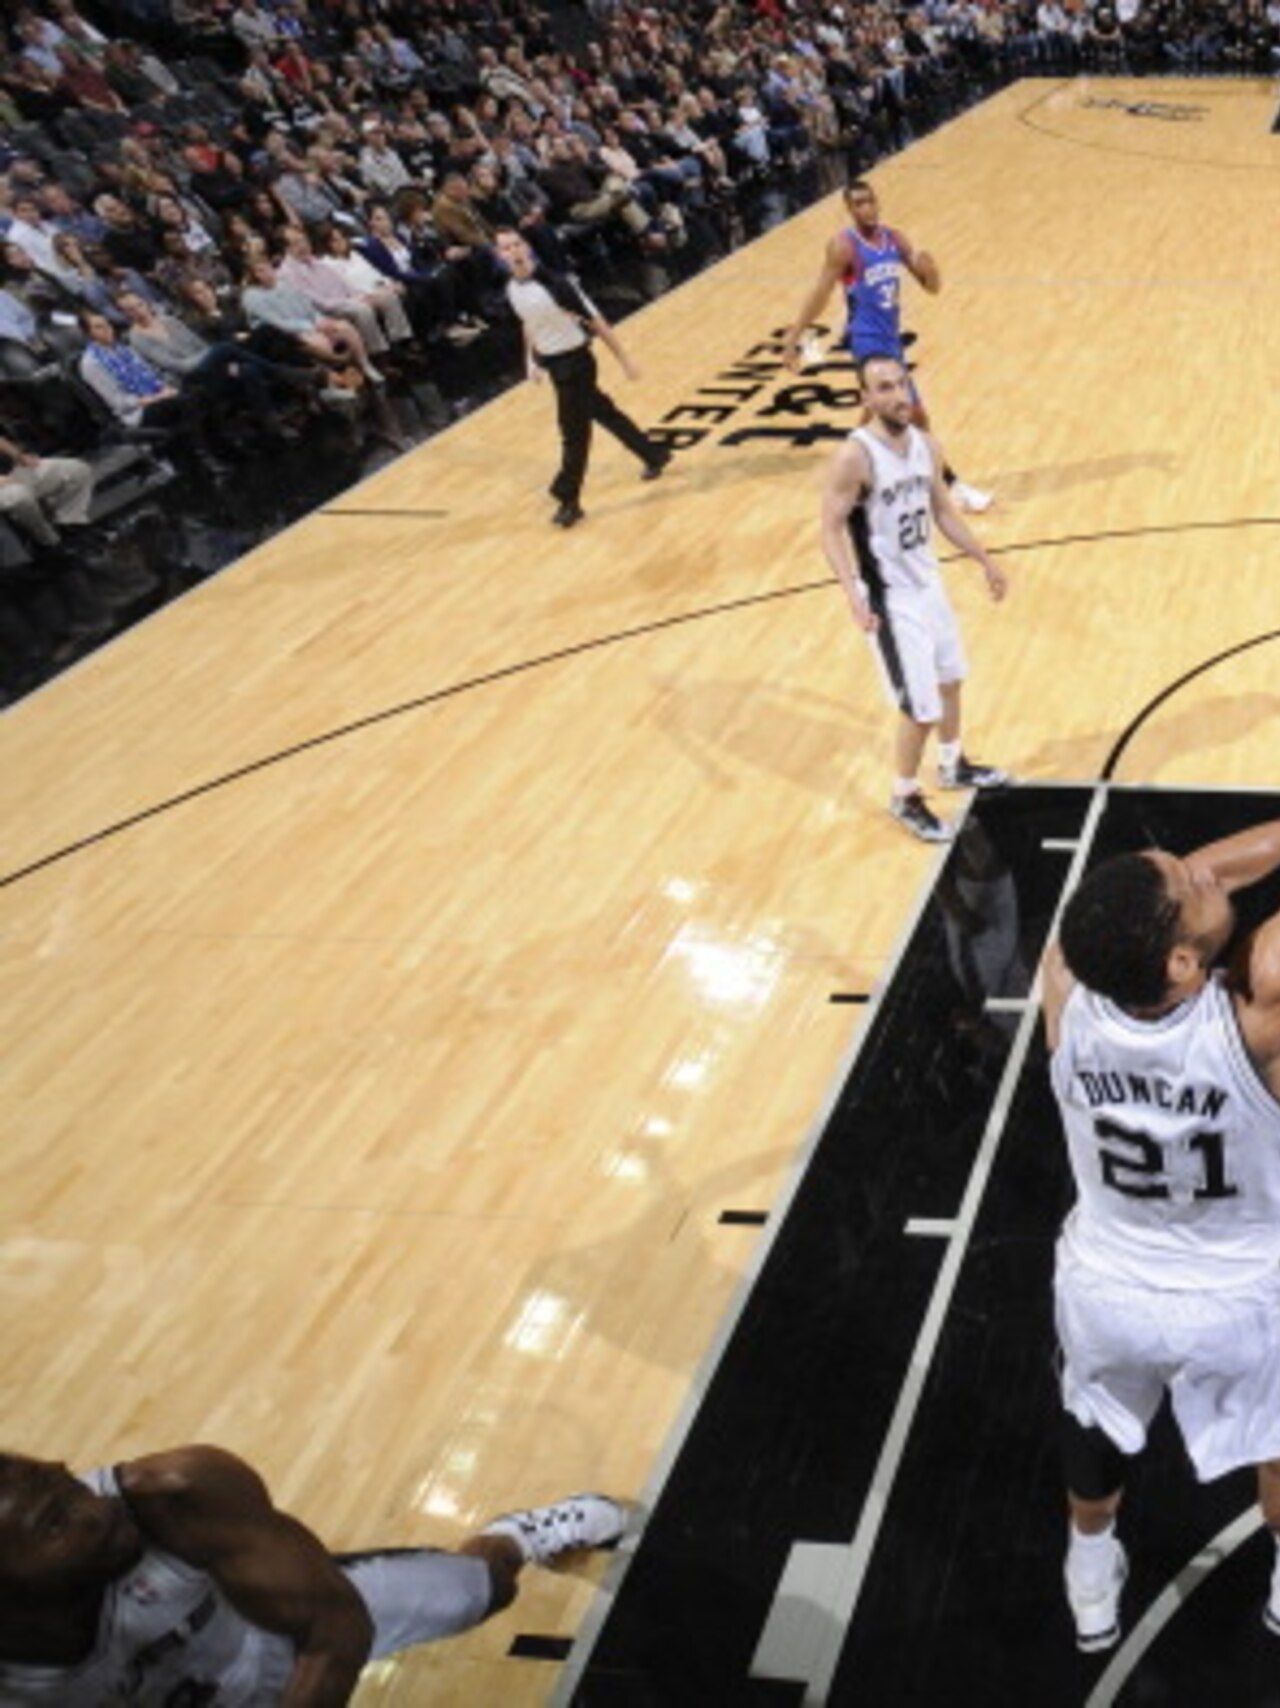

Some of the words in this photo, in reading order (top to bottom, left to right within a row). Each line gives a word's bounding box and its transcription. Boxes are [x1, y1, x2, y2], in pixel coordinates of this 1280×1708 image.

[898, 508, 928, 551] 20
[1076, 1069, 1230, 1121] DUNCAN
[1092, 1117, 1239, 1199] 21
